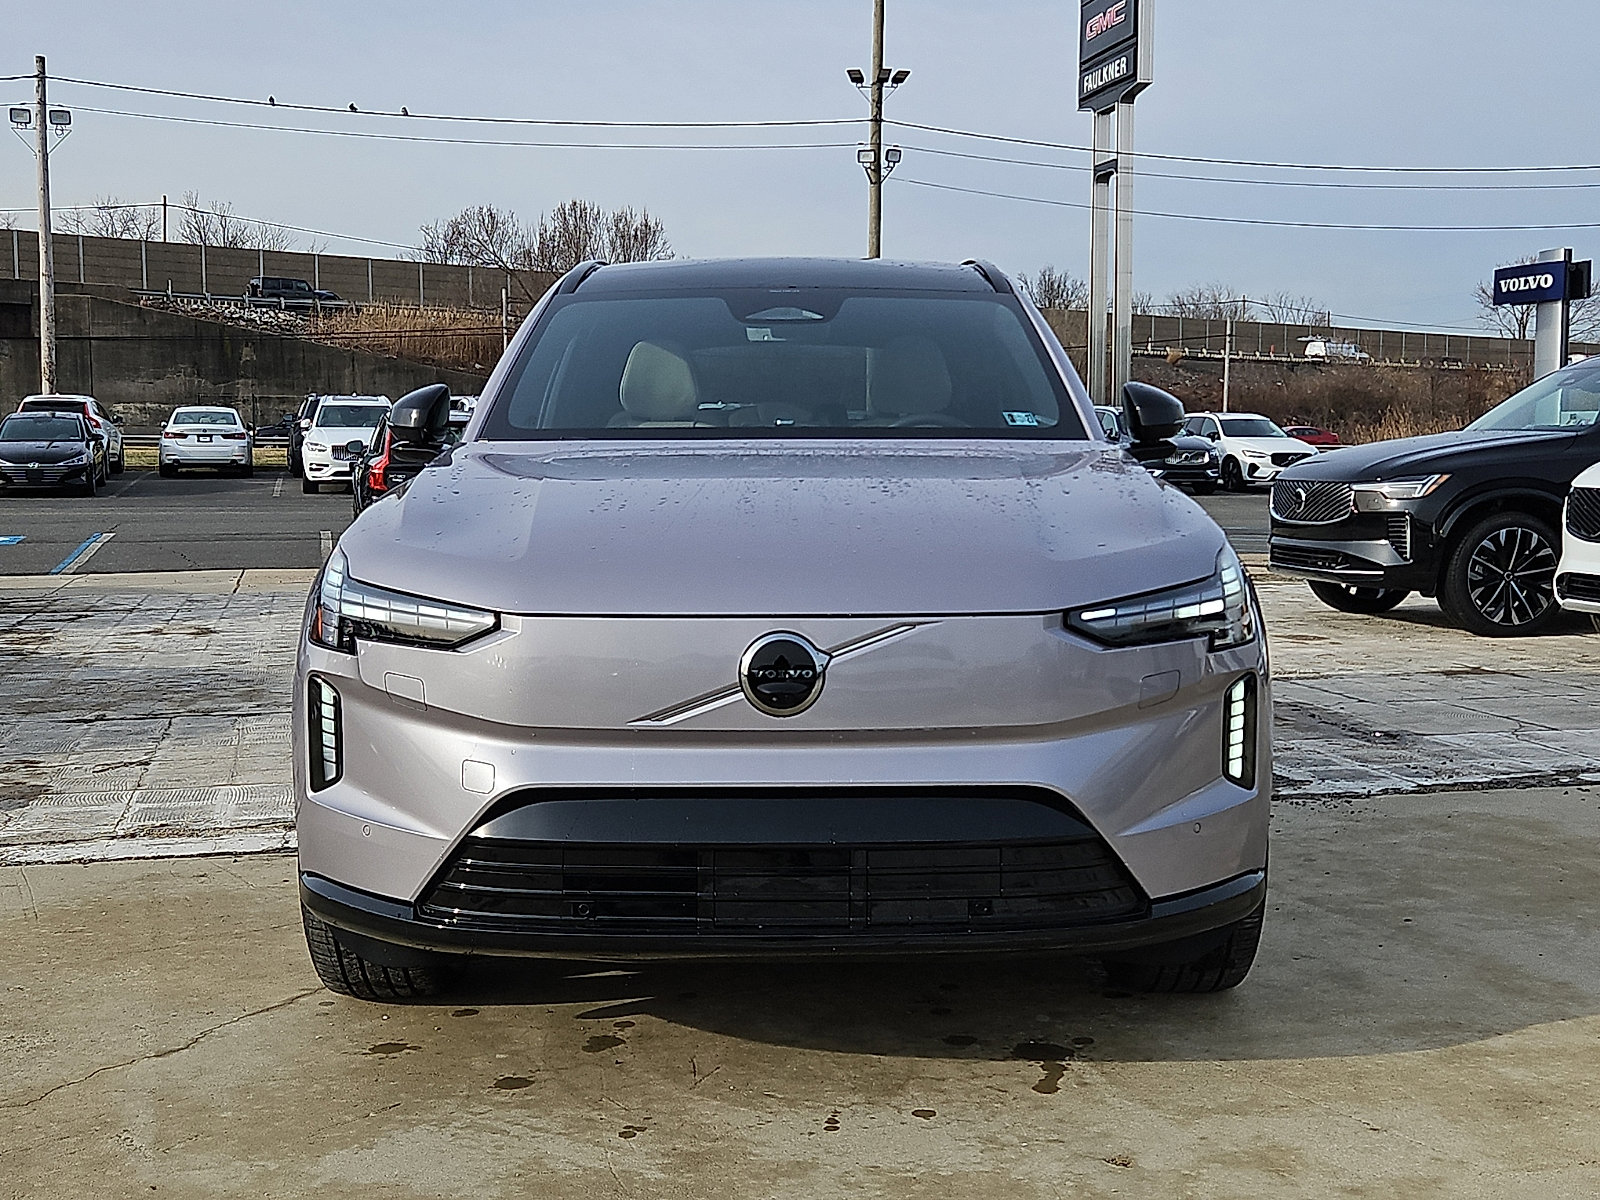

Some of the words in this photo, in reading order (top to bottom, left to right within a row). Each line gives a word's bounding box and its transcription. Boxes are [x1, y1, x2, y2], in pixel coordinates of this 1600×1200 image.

[1086, 0, 1127, 41] GMC
[1083, 56, 1127, 94] FAULKNER
[1499, 273, 1554, 293] VOLVO
[750, 669, 813, 679] VOLVO
